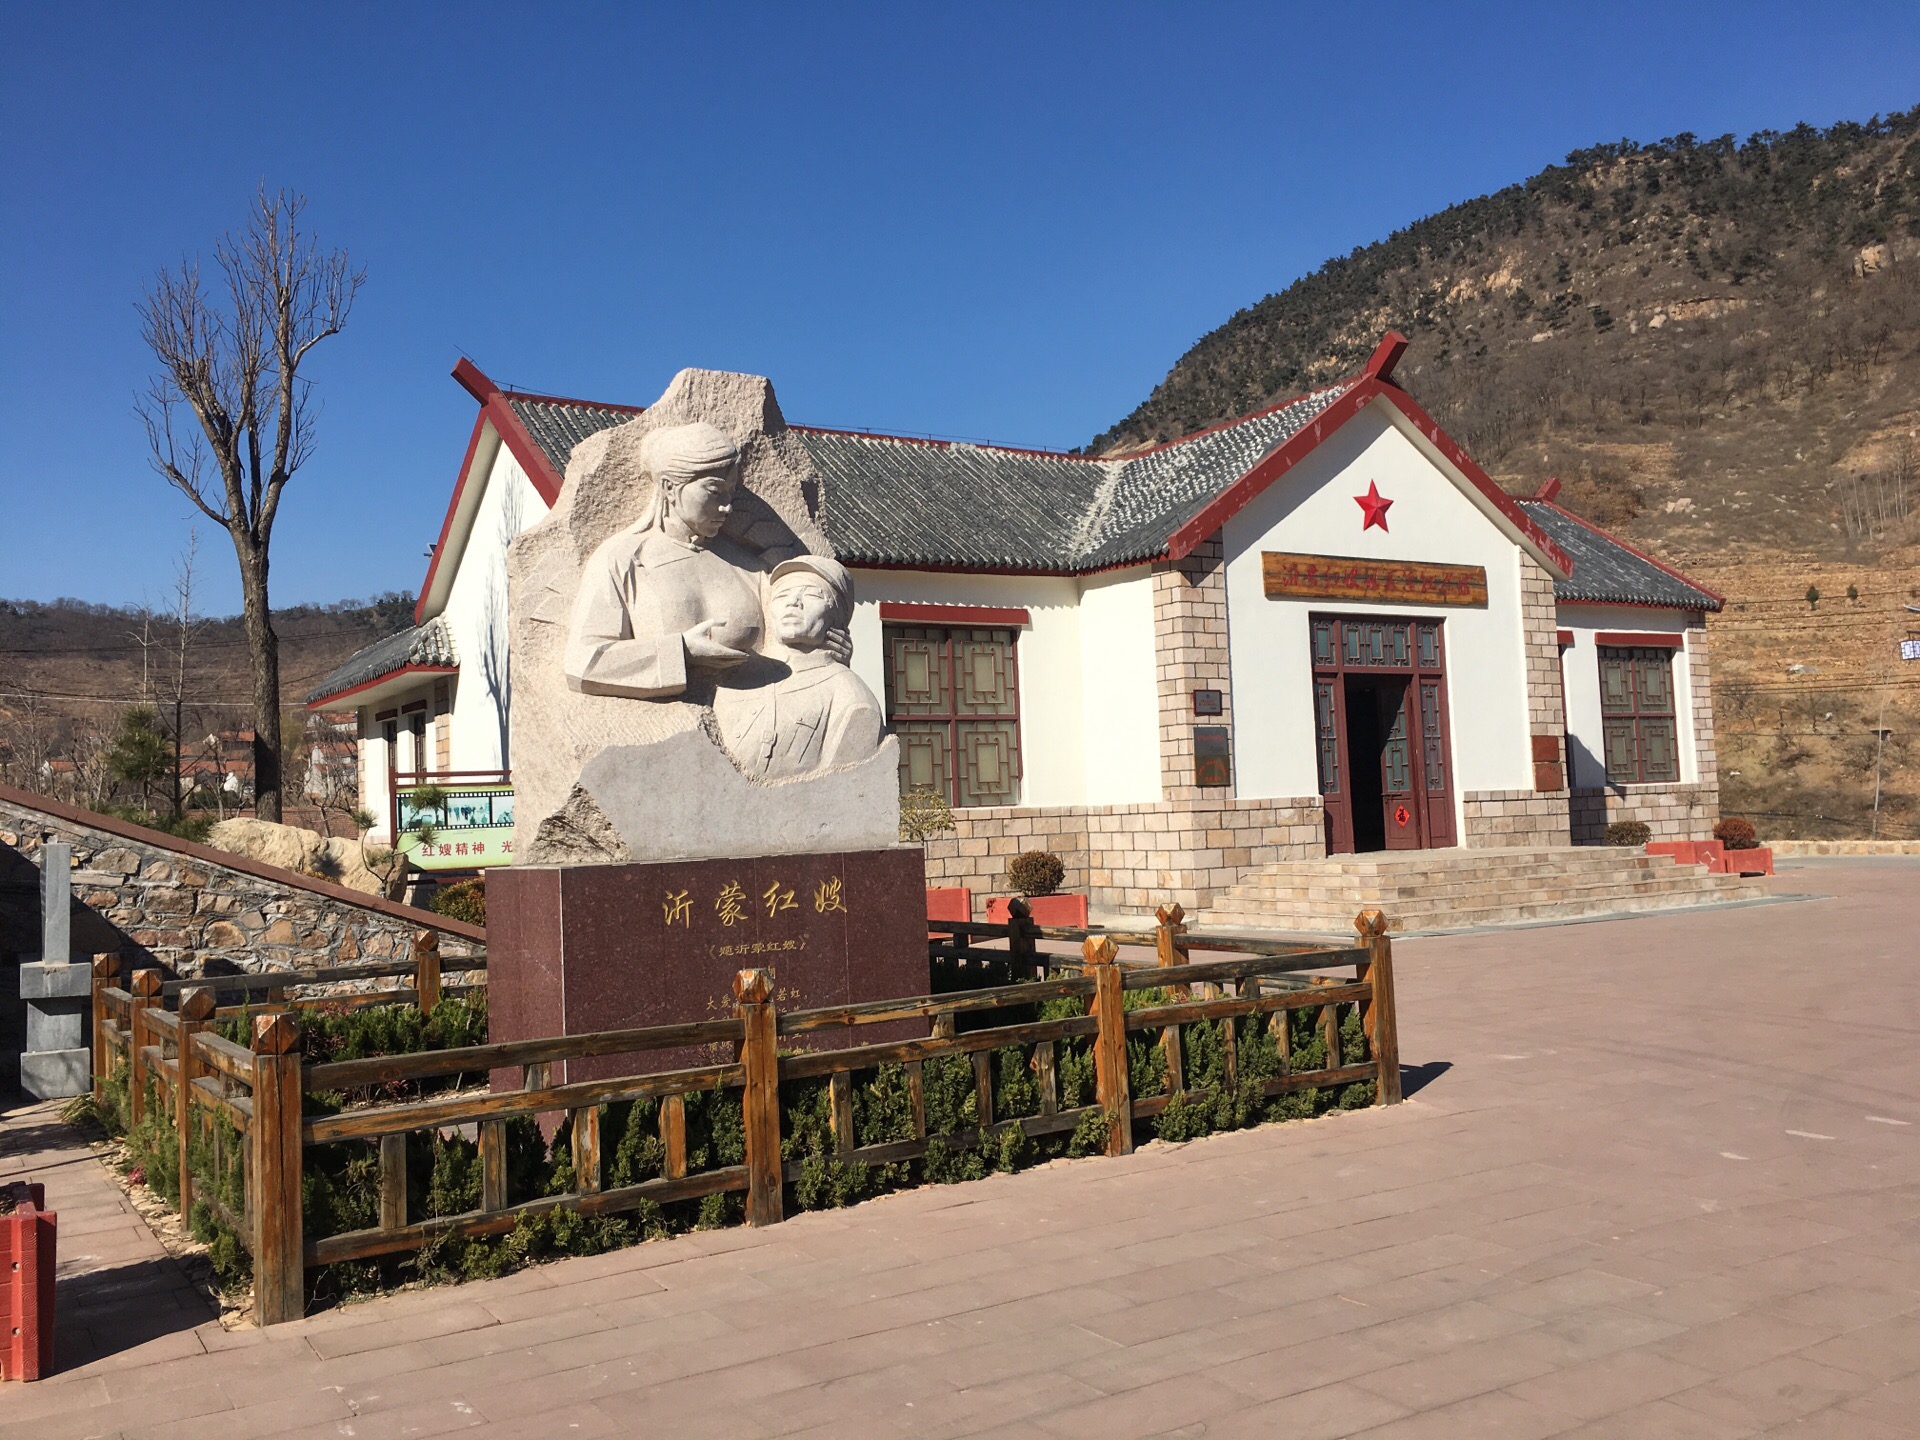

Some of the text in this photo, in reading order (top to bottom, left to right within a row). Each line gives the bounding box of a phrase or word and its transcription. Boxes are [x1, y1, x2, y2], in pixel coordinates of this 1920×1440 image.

[421, 841, 485, 857] 红嫂精神
[662, 875, 848, 929] 沂蒙红嫂
